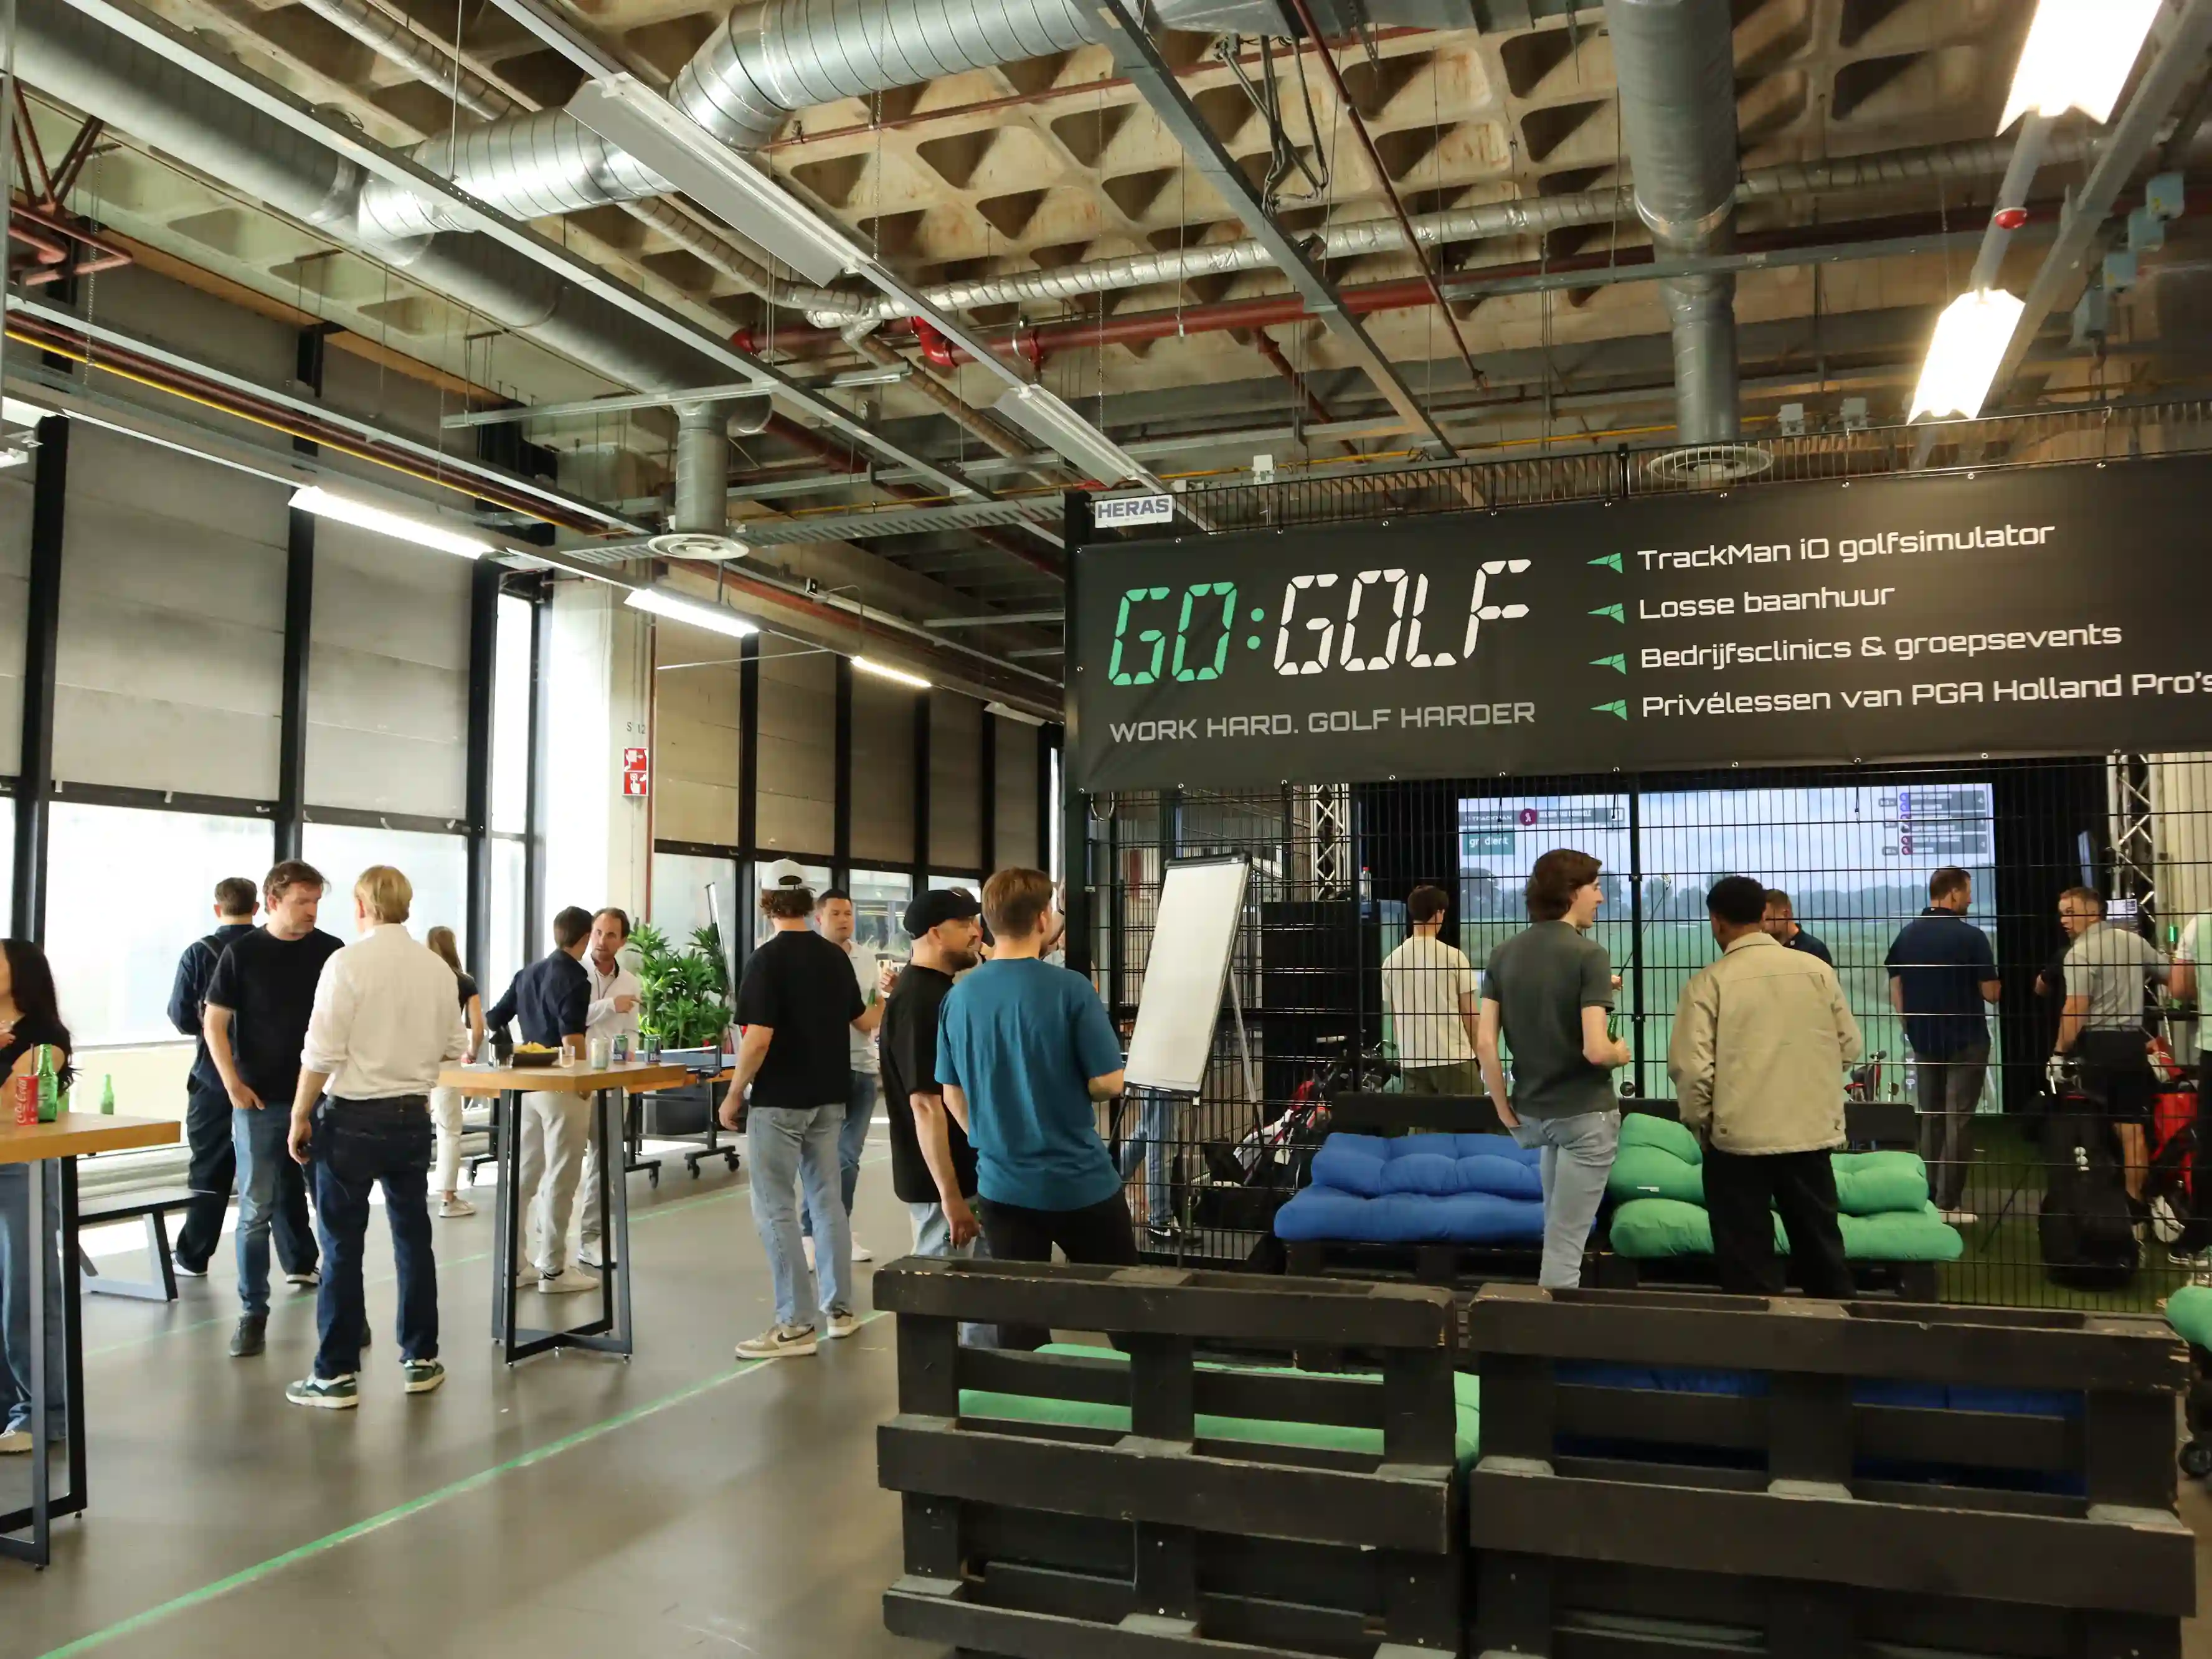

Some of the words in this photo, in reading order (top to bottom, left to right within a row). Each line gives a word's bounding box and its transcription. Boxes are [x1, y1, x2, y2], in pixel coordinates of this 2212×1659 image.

[1097, 498, 1170, 518] HERAS
[1637, 543, 1791, 570] TrackMan
[1838, 524, 2056, 563] golfsimulator
[1640, 597, 1735, 619] Losse
[1744, 586, 1896, 613] baanhuur
[1641, 638, 1851, 670] Bedrijfsclinics
[1861, 636, 1886, 657] &
[1894, 623, 2122, 661] groepsevents
[1643, 691, 1831, 717] Privélessen
[1840, 689, 1902, 708] van
[1912, 681, 1983, 706] PGA
[1993, 674, 2122, 702] Holland
[2132, 671, 2212, 696] Pro's
[626, 722, 632, 732] S
[638, 724, 646, 734] 12
[1109, 719, 1198, 743] WORK
[1207, 714, 1298, 738] HARD.
[1308, 709, 1391, 733] GOLF
[1401, 702, 1535, 729] HARDER
